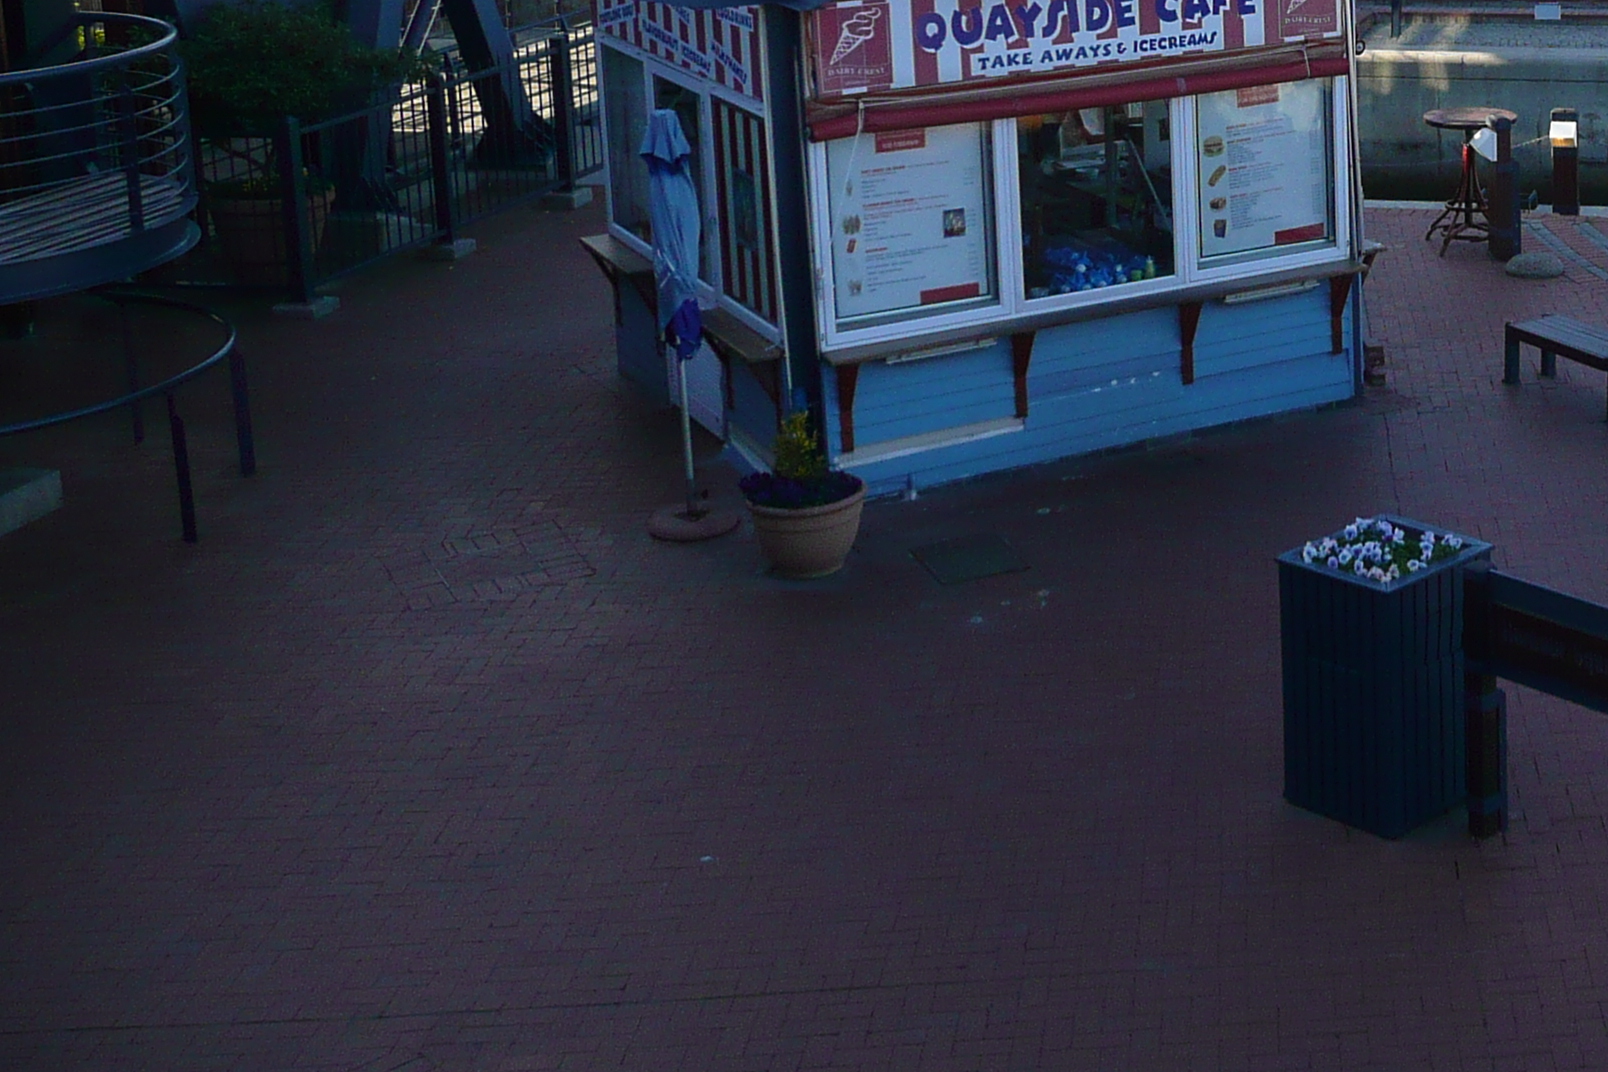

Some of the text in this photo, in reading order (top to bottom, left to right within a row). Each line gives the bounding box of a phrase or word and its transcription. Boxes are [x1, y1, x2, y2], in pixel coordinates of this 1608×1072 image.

[977, 30, 1218, 72] TAKE AWAYS & ICECREAMS
